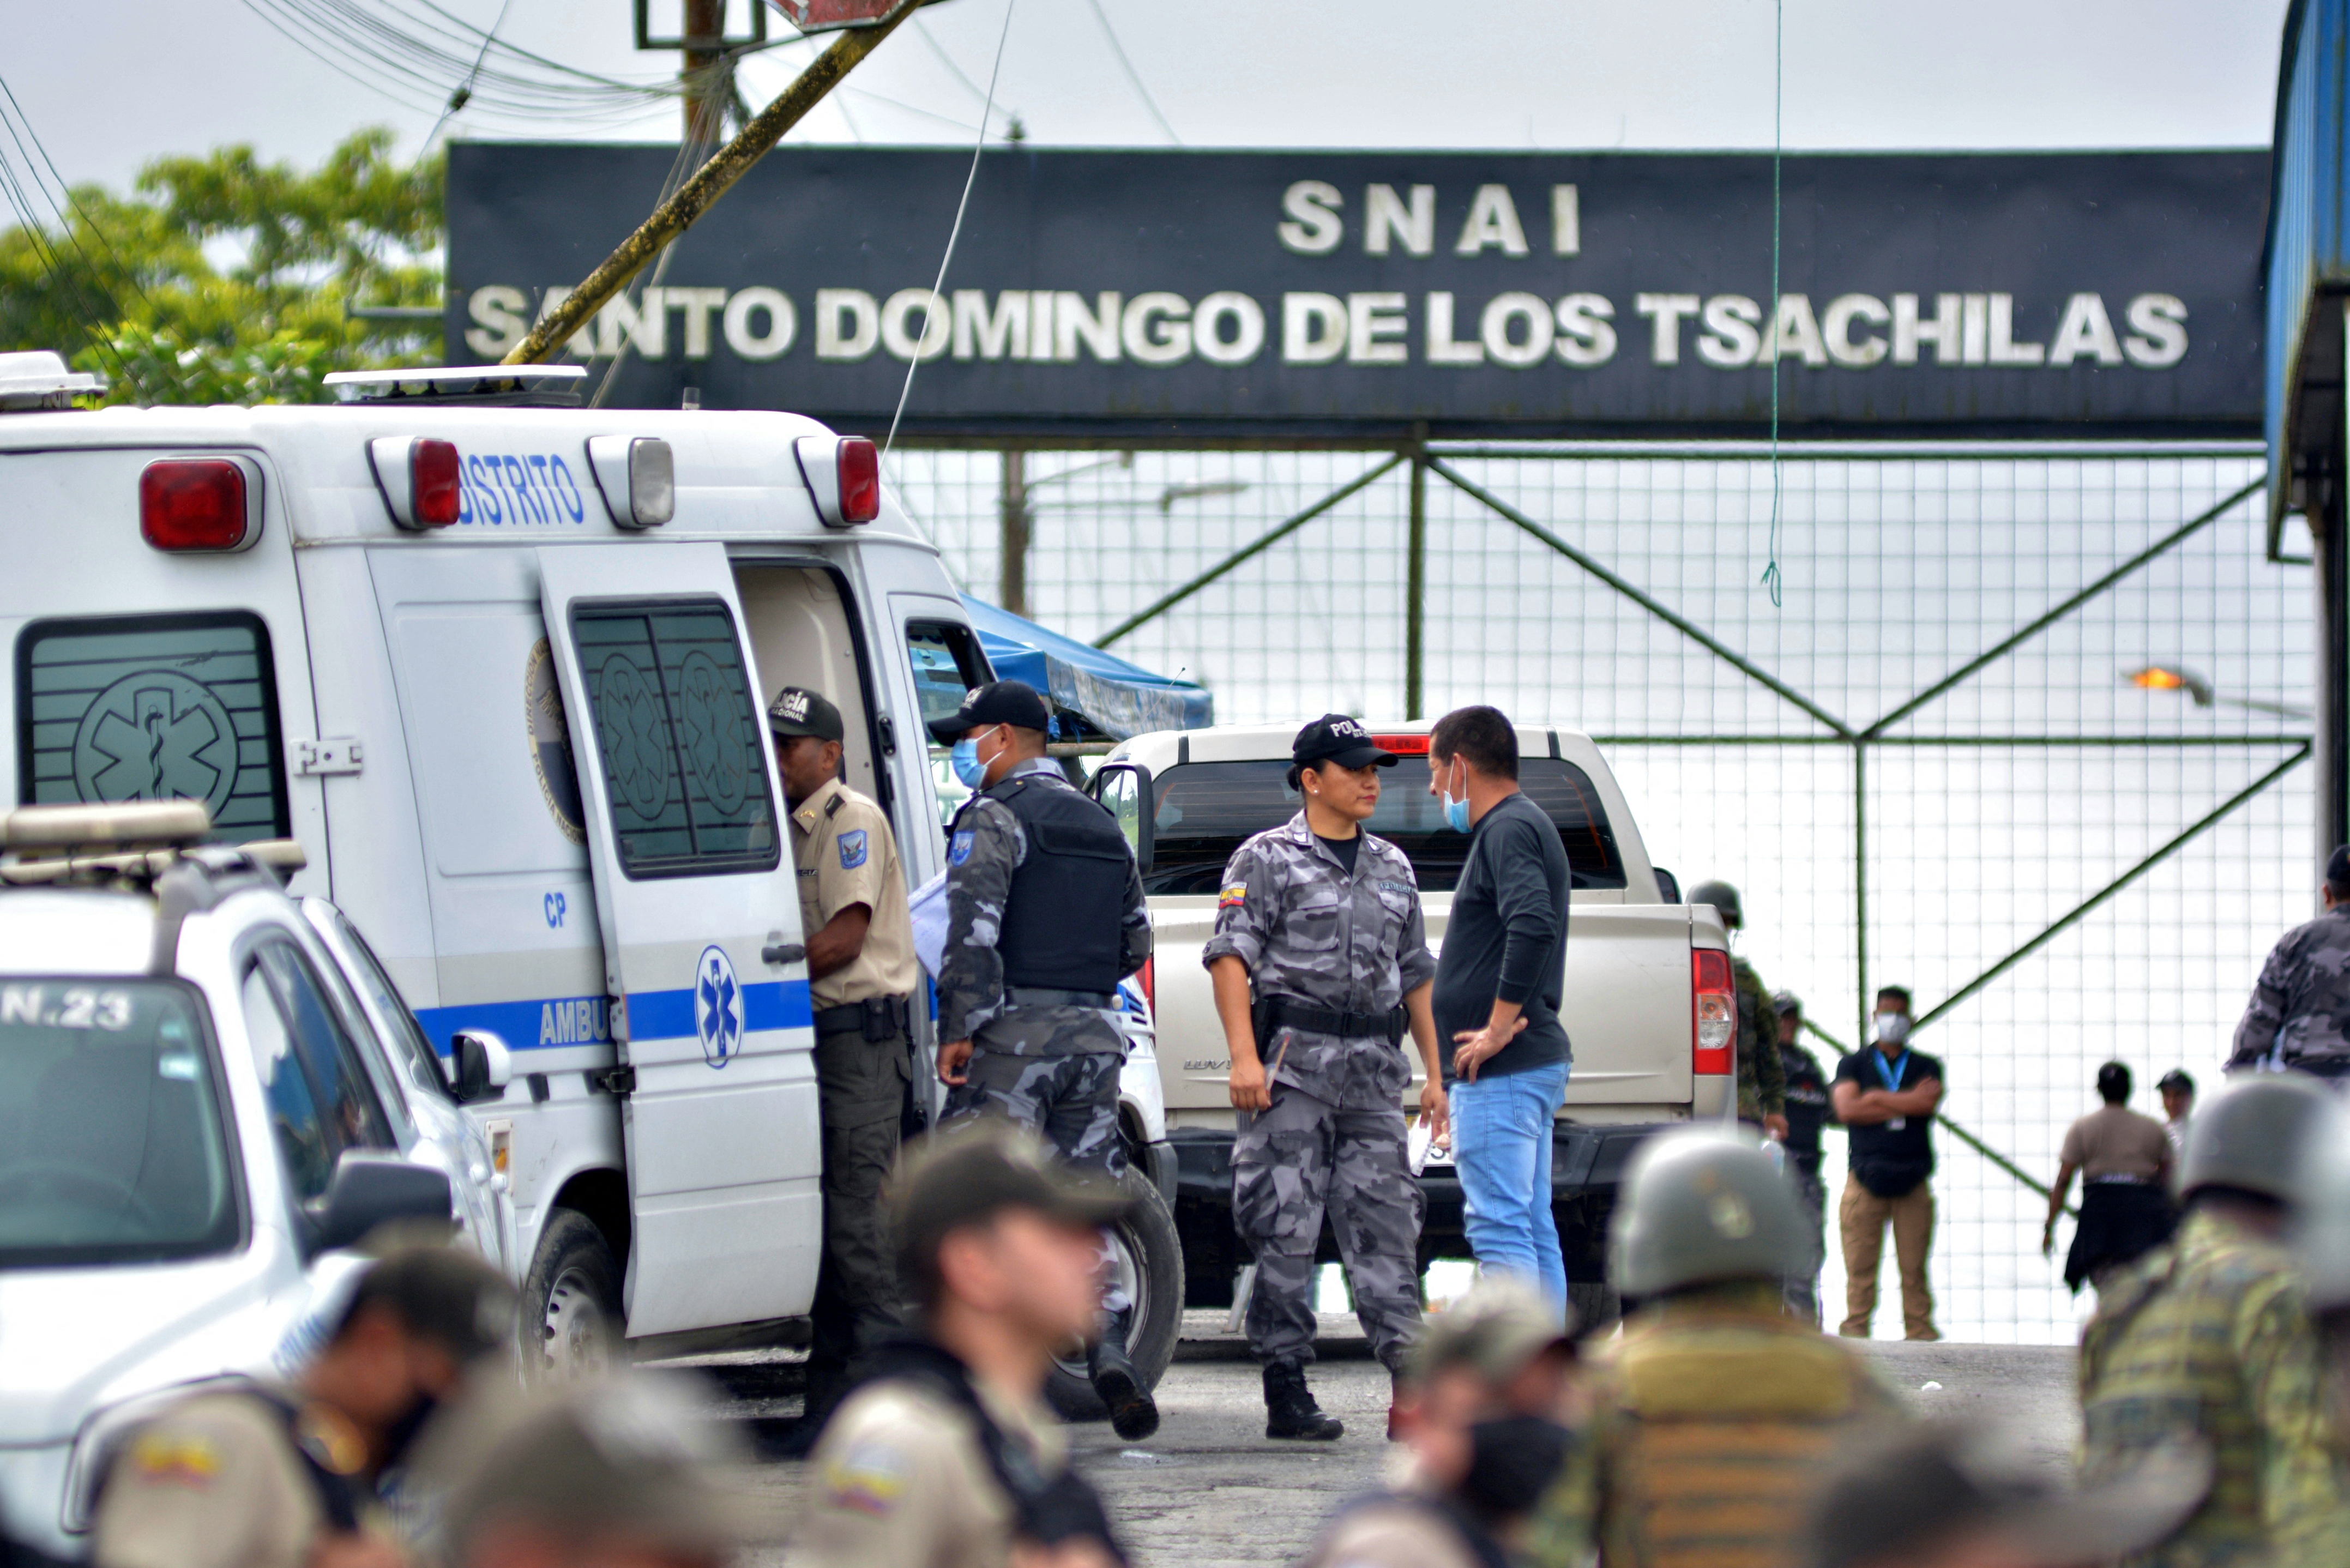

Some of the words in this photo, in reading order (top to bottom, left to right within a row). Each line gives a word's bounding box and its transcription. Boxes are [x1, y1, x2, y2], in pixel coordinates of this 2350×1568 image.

[816, 288, 1266, 365] DOMINGO
[1282, 291, 1408, 364] DE
[1425, 291, 1618, 366] LOS
[1636, 292, 2189, 367] TSACHILAS
[544, 892, 566, 928] CP
[539, 999, 608, 1045] AMBU
[1184, 1059, 1226, 1070] LUV
